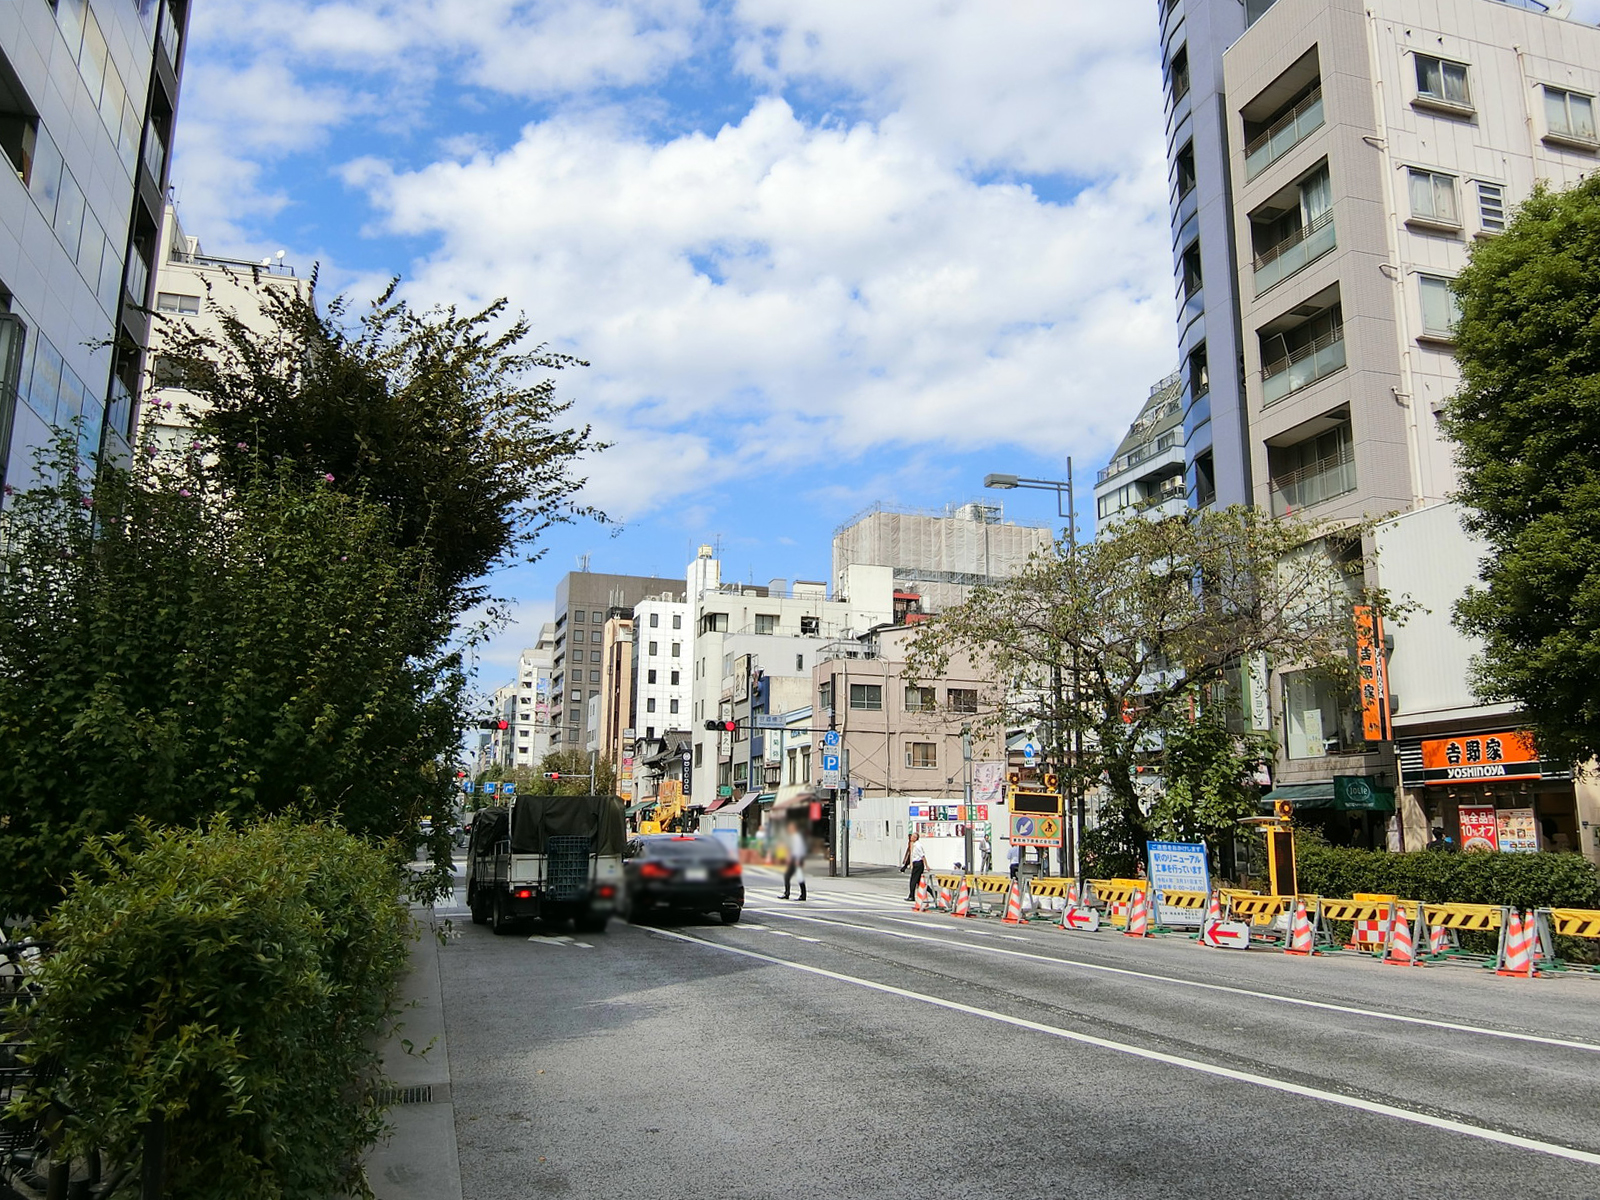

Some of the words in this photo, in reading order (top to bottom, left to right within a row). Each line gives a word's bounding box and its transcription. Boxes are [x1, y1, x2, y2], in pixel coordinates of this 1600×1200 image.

[1360, 646, 1375, 698] 吉野家
[1446, 737, 1503, 764] 吉野家
[828, 757, 837, 770] P
[1447, 765, 1506, 780] YOSHINOYA
[1151, 844, 1202, 853] ご迷惑をおかけします
[1154, 853, 1202, 865] 駅のリニューアル
[1155, 864, 1202, 875] 工事を行っています
